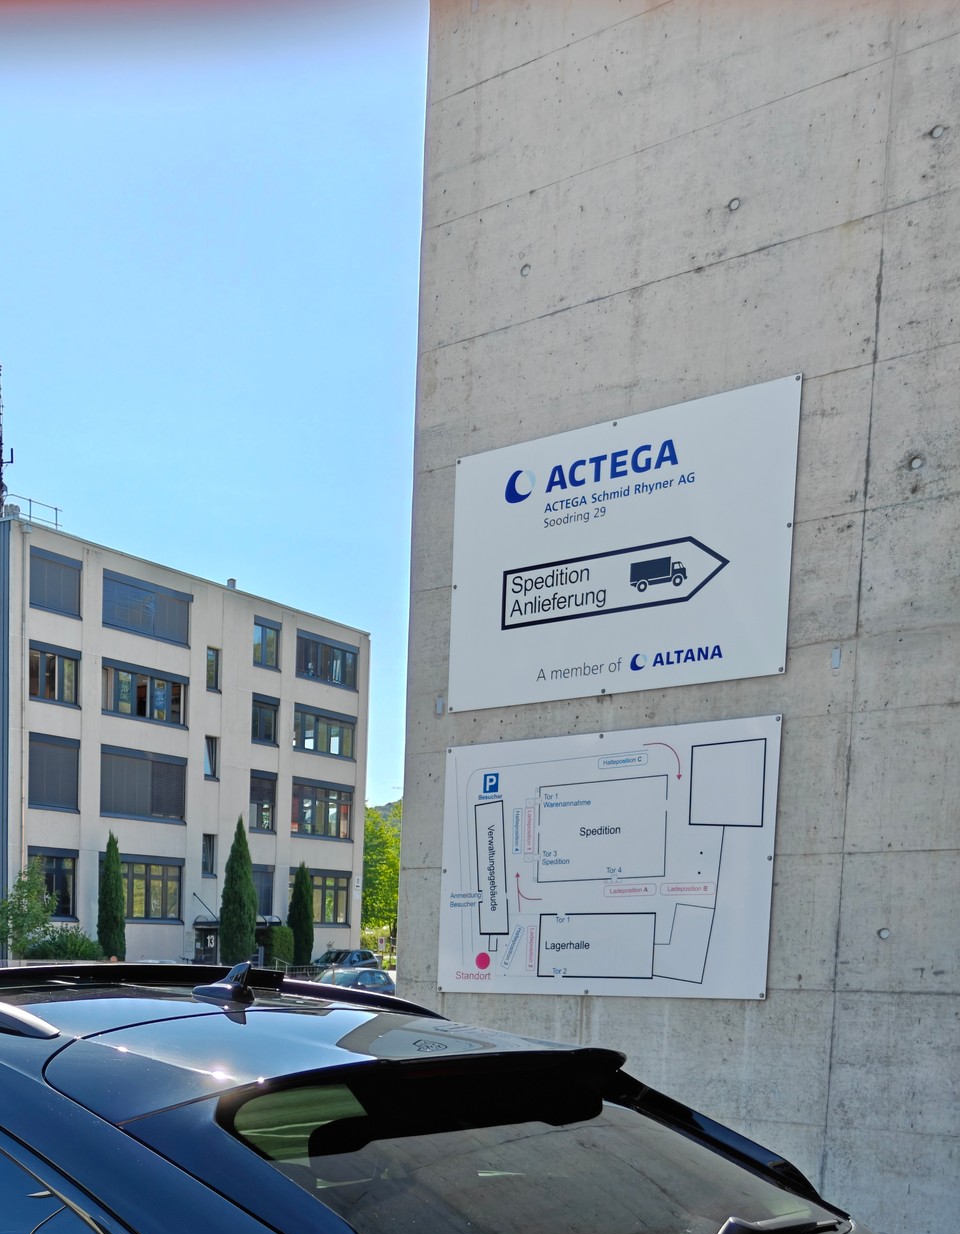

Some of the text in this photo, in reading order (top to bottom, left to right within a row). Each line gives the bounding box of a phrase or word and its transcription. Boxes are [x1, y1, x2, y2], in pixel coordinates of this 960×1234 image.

[545, 439, 679, 493] ACTEGA
[544, 472, 695, 513] ACTEGA Schmid Rhyner AG
[544, 507, 606, 528] Soodring 29
[511, 567, 590, 596] Spedition
[510, 589, 607, 618] Anlieferung
[652, 645, 723, 667] ALTANA
[536, 657, 622, 682] A member of
[543, 800, 591, 808] Warenannahme
[544, 793, 554, 801] Tor
[579, 825, 621, 838] Spedition
[487, 824, 498, 911] Verwaltungsgebäude
[542, 858, 570, 866] Spedition
[207, 935, 215, 948] 13
[545, 941, 590, 952] Lagerhalle
[455, 971, 490, 980] Standort
